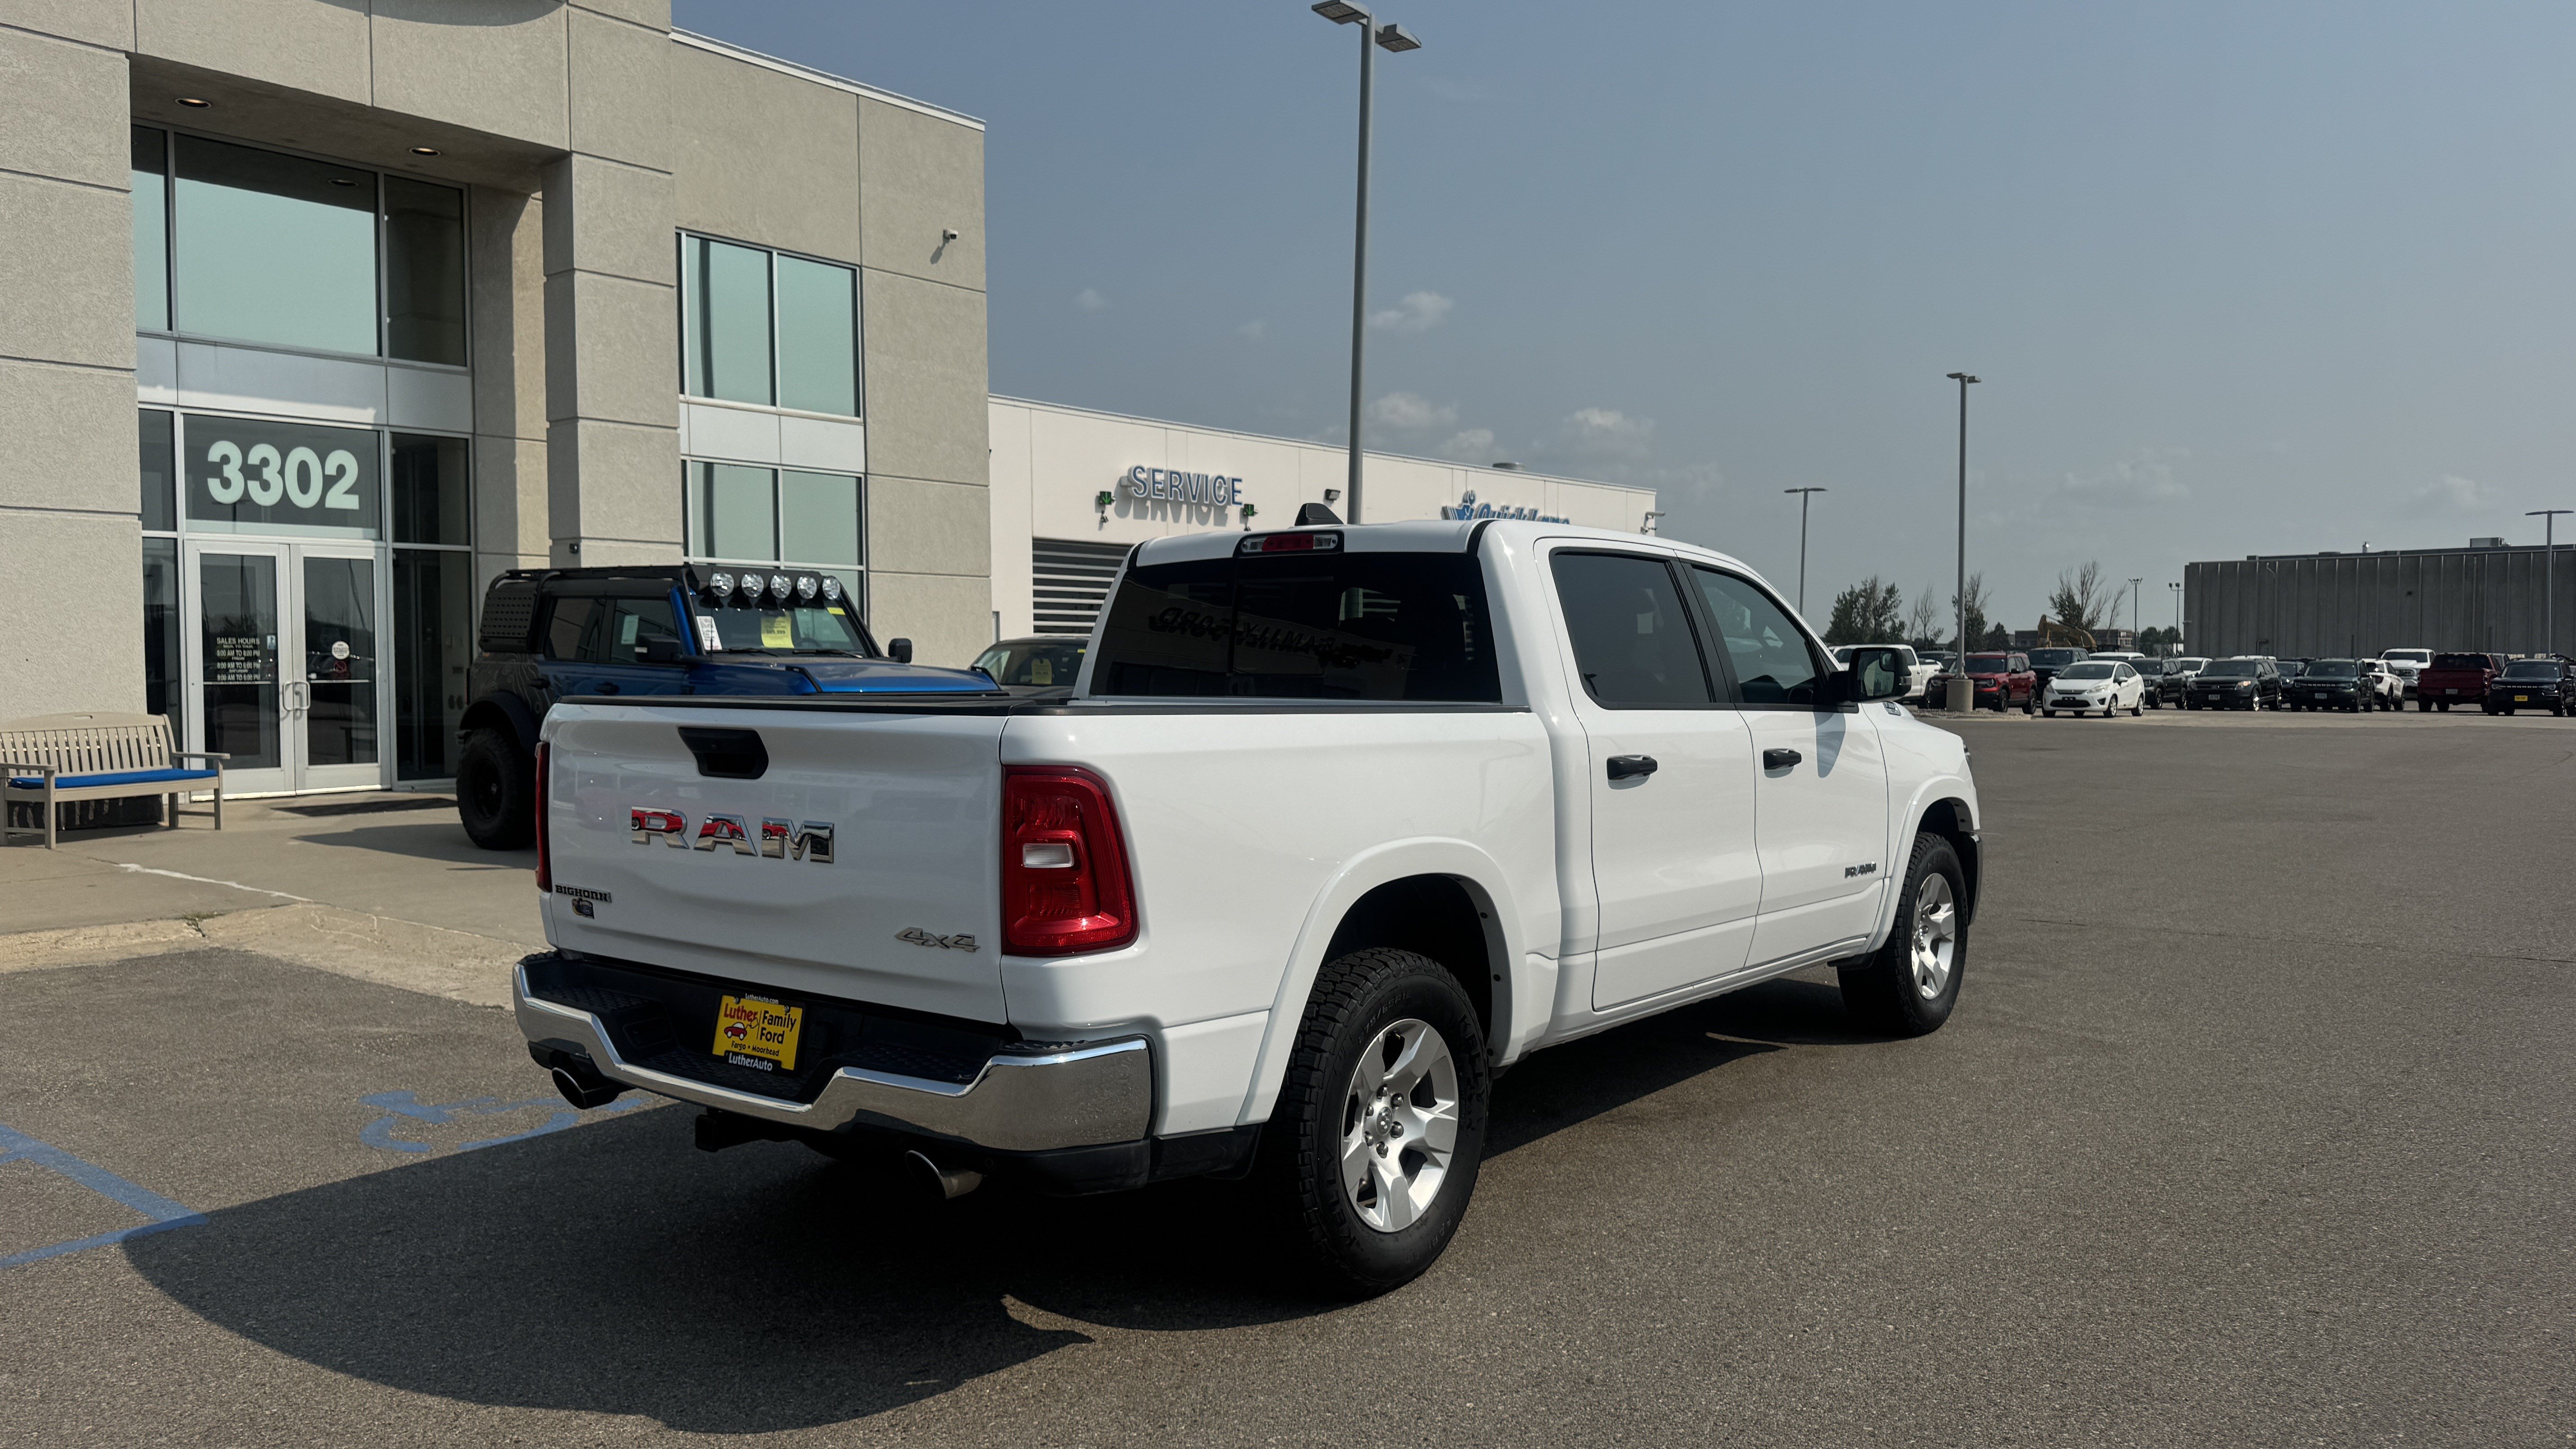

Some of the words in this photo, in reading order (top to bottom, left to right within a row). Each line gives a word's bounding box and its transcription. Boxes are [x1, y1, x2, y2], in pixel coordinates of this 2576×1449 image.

[207, 440, 359, 510] 3302
[1131, 465, 1243, 506] SERVICE
[217, 637, 236, 645] SALES
[631, 806, 834, 864] RAM
[1845, 862, 1877, 879] RAM
[555, 884, 608, 902] BIGHORN
[745, 993, 779, 1004] LutherAuto.com
[723, 1003, 758, 1022] Luther
[762, 1010, 797, 1032] Family
[759, 1026, 785, 1044] Ford
[731, 1040, 746, 1051] Fargo
[751, 1044, 780, 1057] Moorhead
[728, 1052, 773, 1072] LutherAuto
[1458, 1013, 1486, 1107] KELLY
